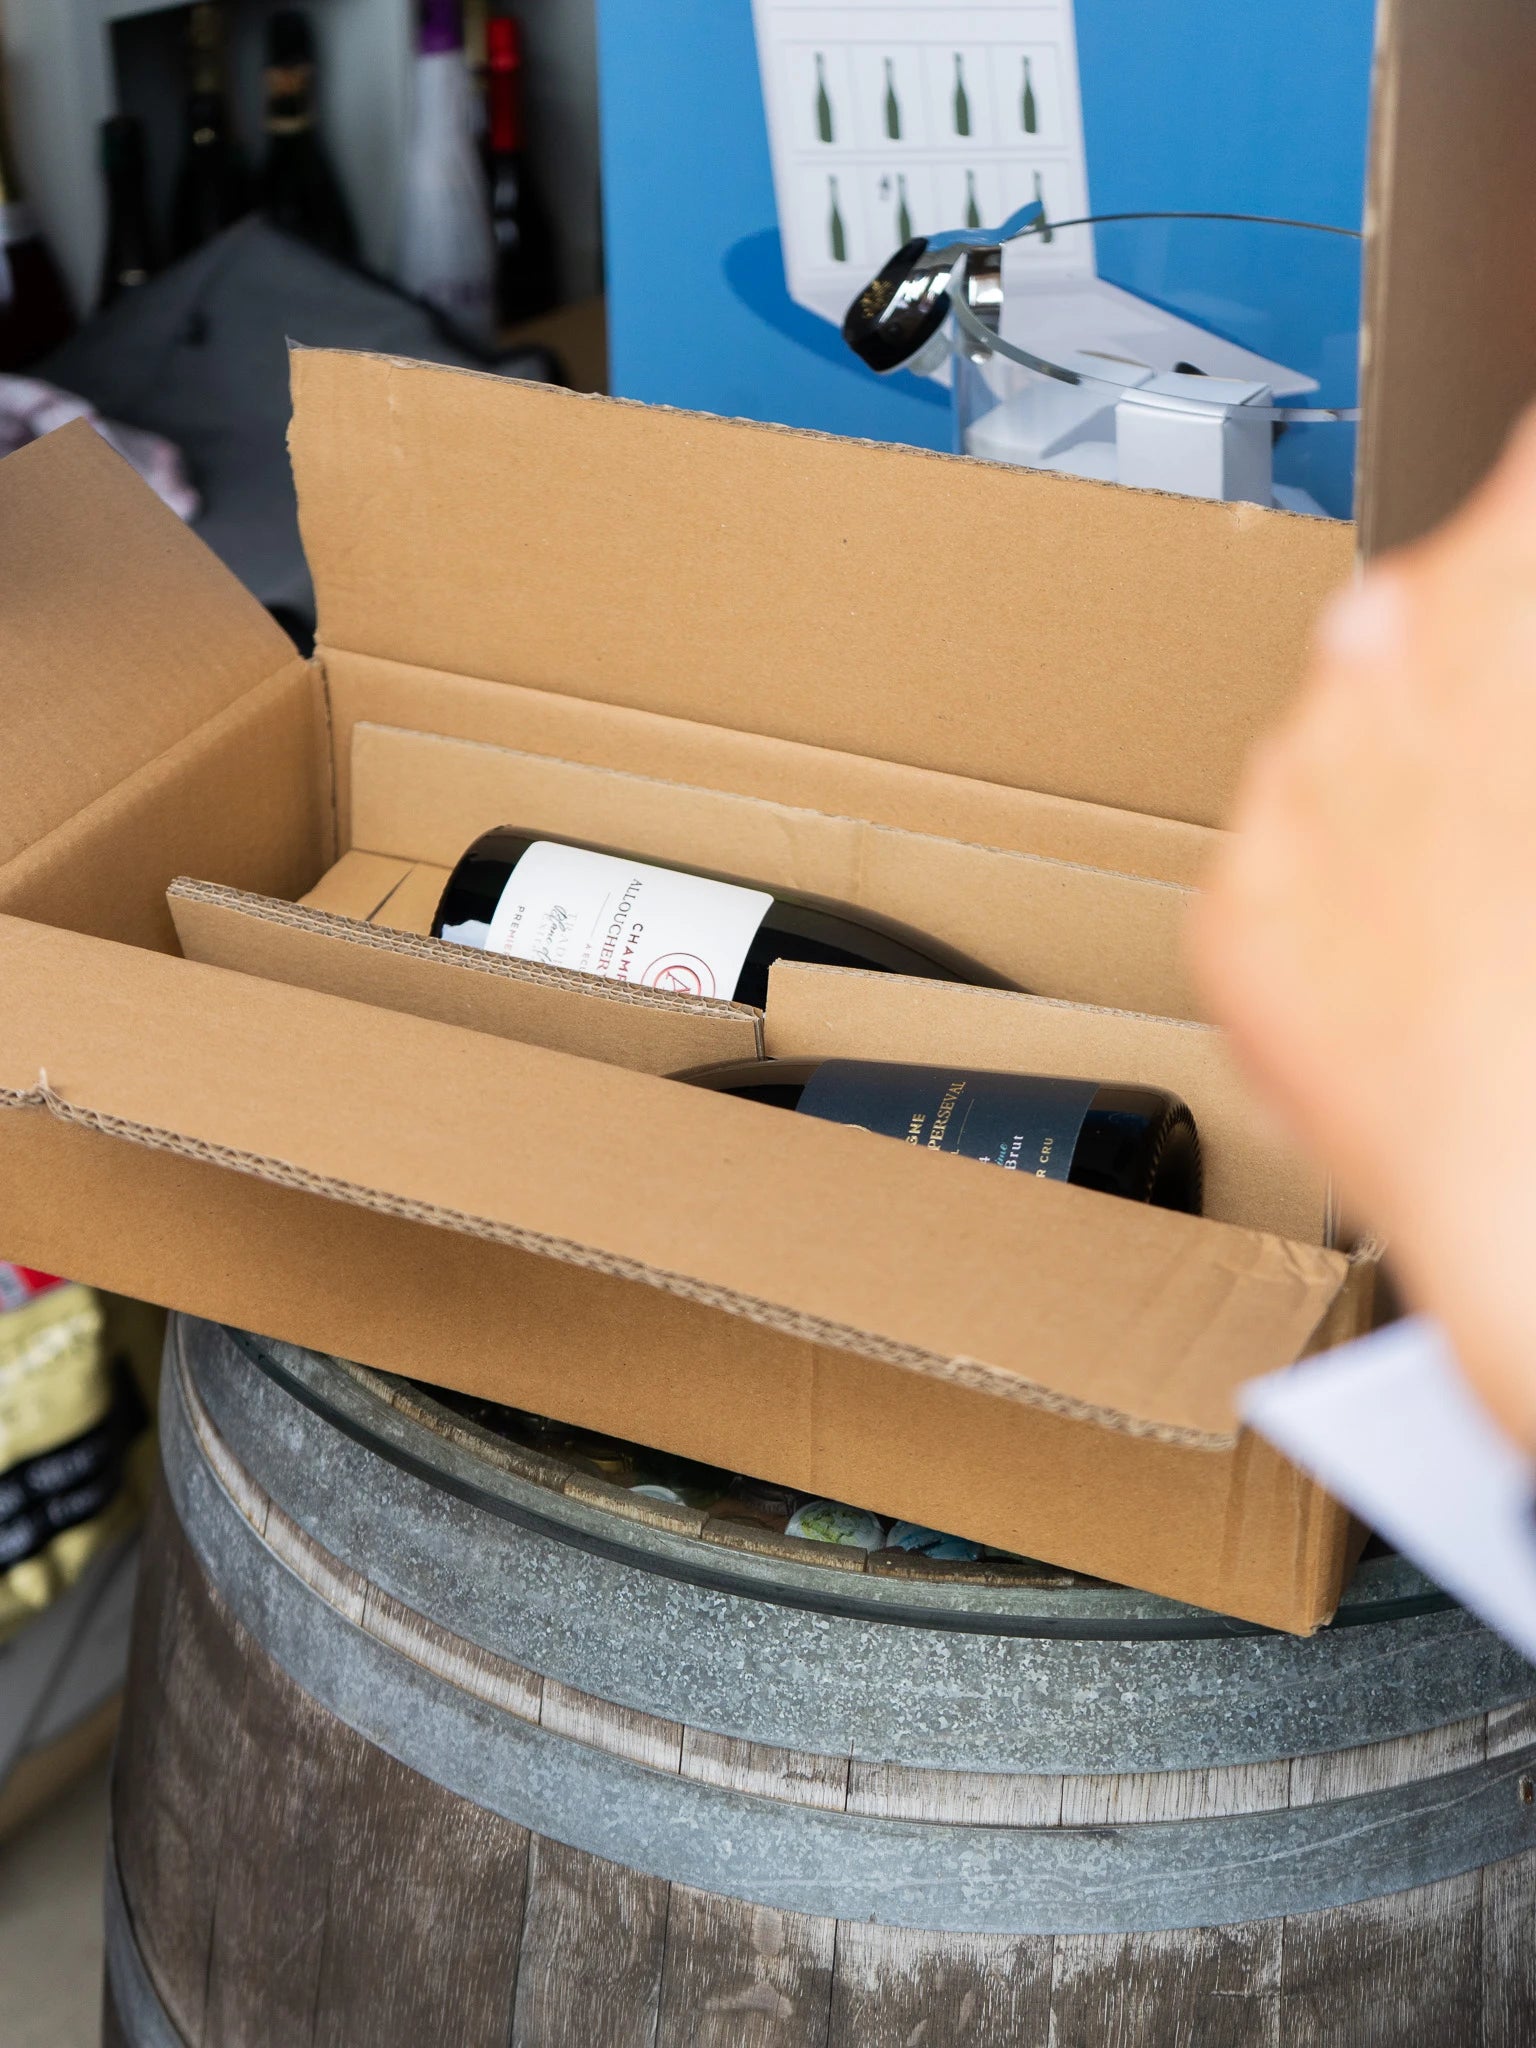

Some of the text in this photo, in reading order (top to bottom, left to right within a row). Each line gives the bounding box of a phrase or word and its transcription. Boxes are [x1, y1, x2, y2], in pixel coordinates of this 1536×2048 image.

[596, 878, 643, 977] ALLOUCHER
[928, 1081, 967, 1151] PERSEVAL
[1004, 1135, 1024, 1170] Brut
[1039, 1137, 1054, 1164] CRU
